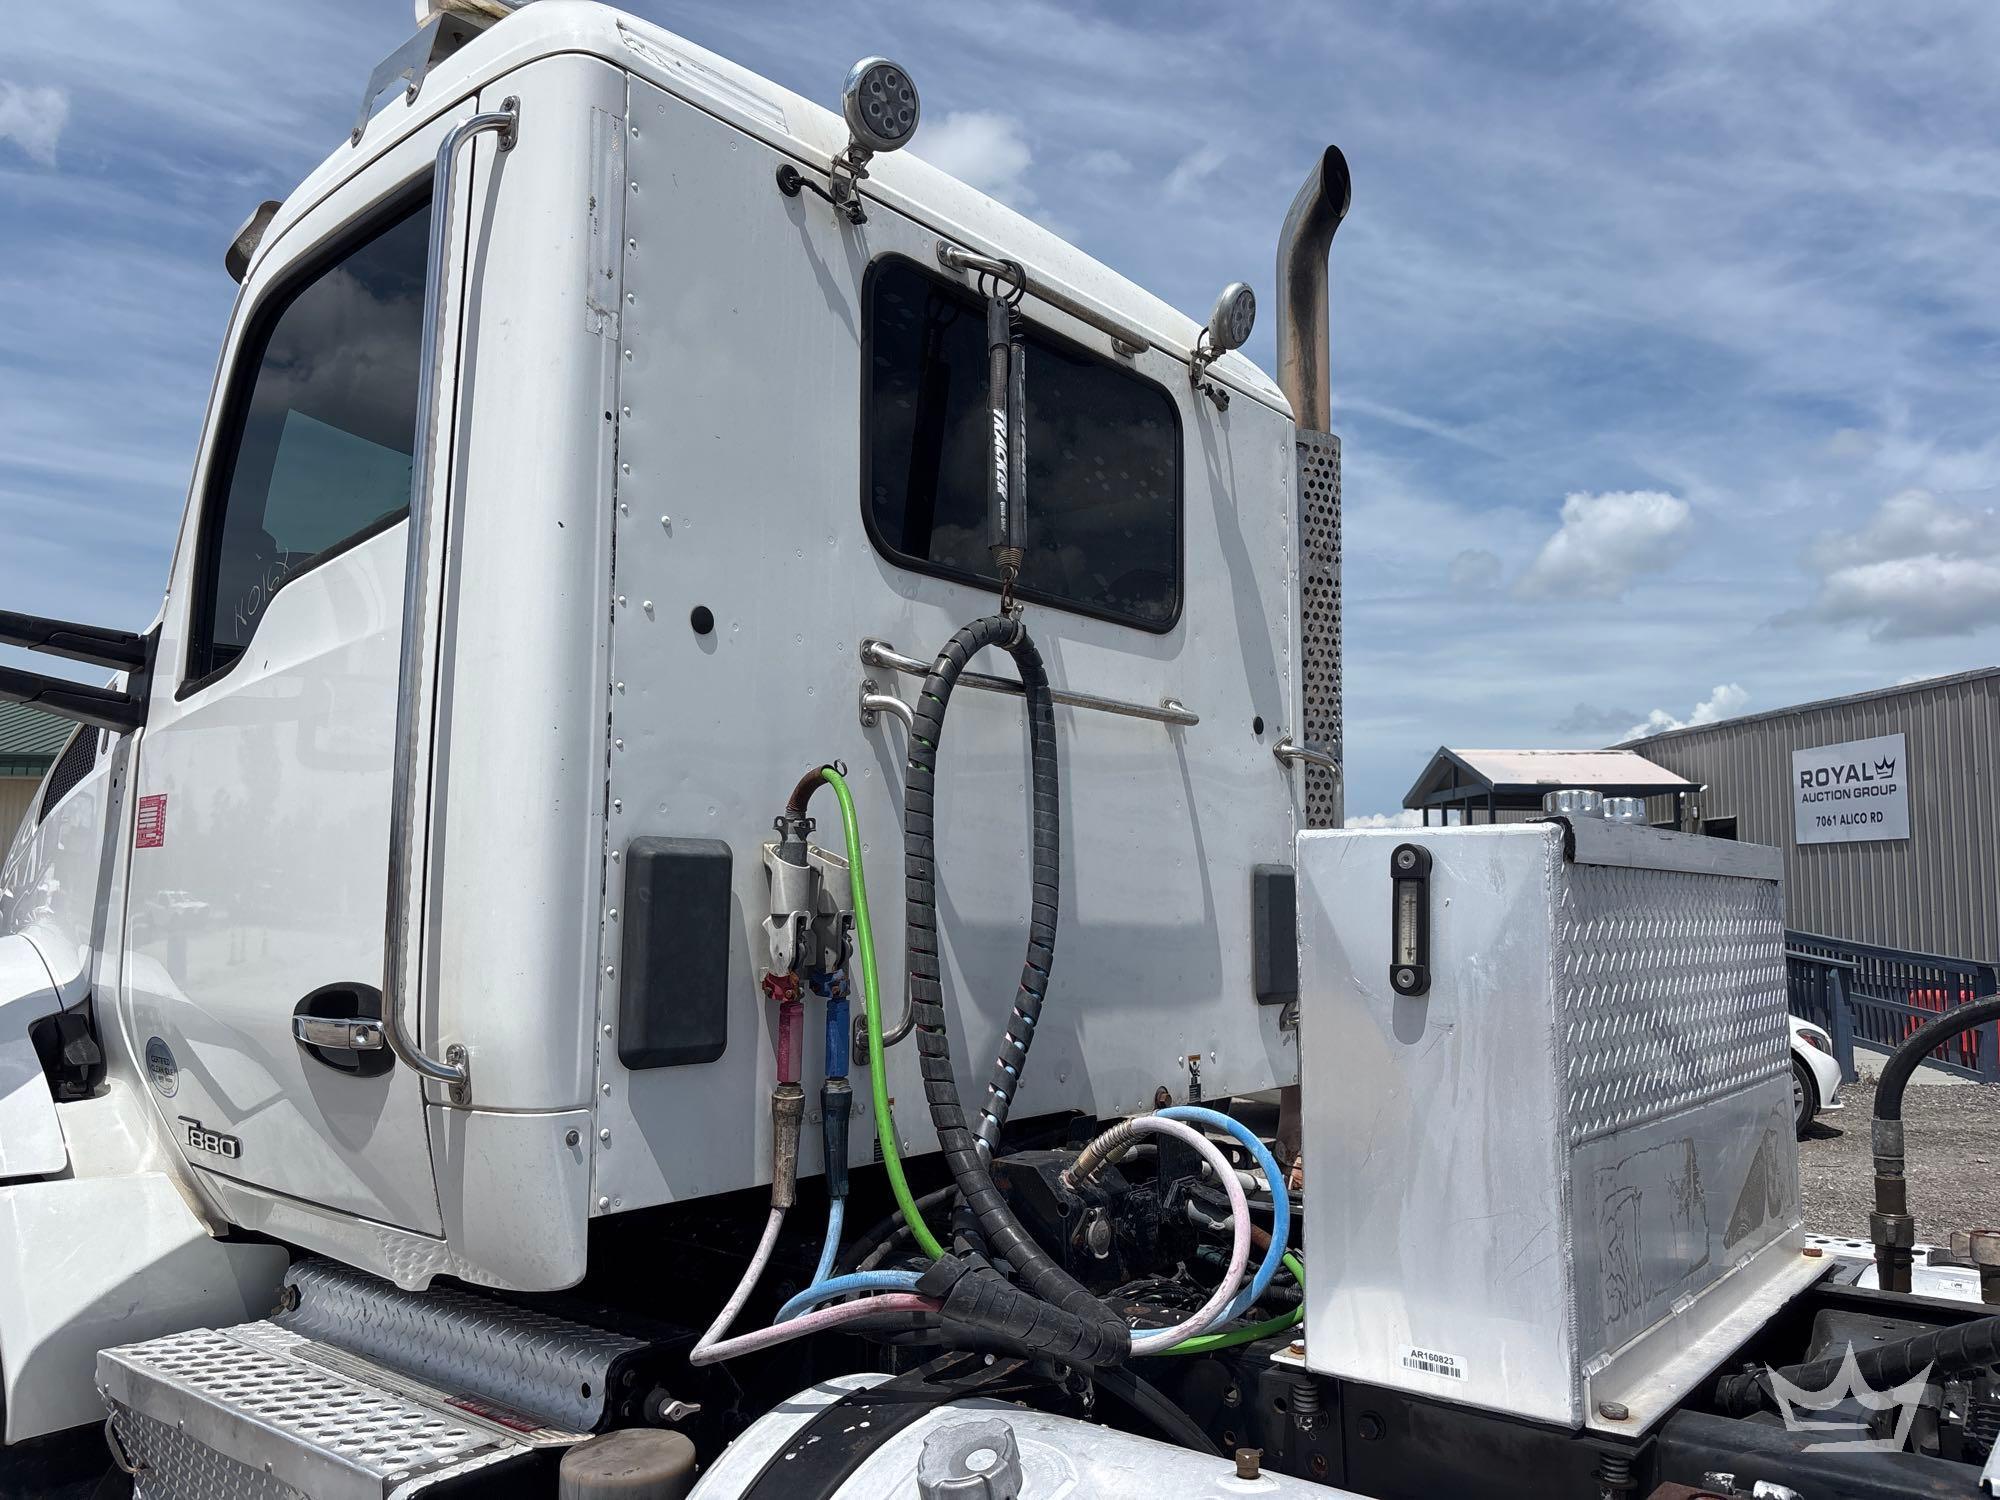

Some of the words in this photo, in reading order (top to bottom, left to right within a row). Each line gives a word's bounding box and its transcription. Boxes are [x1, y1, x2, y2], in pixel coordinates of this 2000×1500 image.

[993, 408, 1008, 501] TRACKER
[1800, 762, 1874, 788] ROYAL
[1801, 788, 1851, 804] AUCTION
[1853, 784, 1897, 798] GROUP
[1816, 815, 1837, 828] 7061
[1840, 812, 1867, 826] ALICO
[1870, 811, 1883, 823] RD
[178, 1116, 241, 1159] T880
[1410, 1349, 1454, 1366] AR160823
